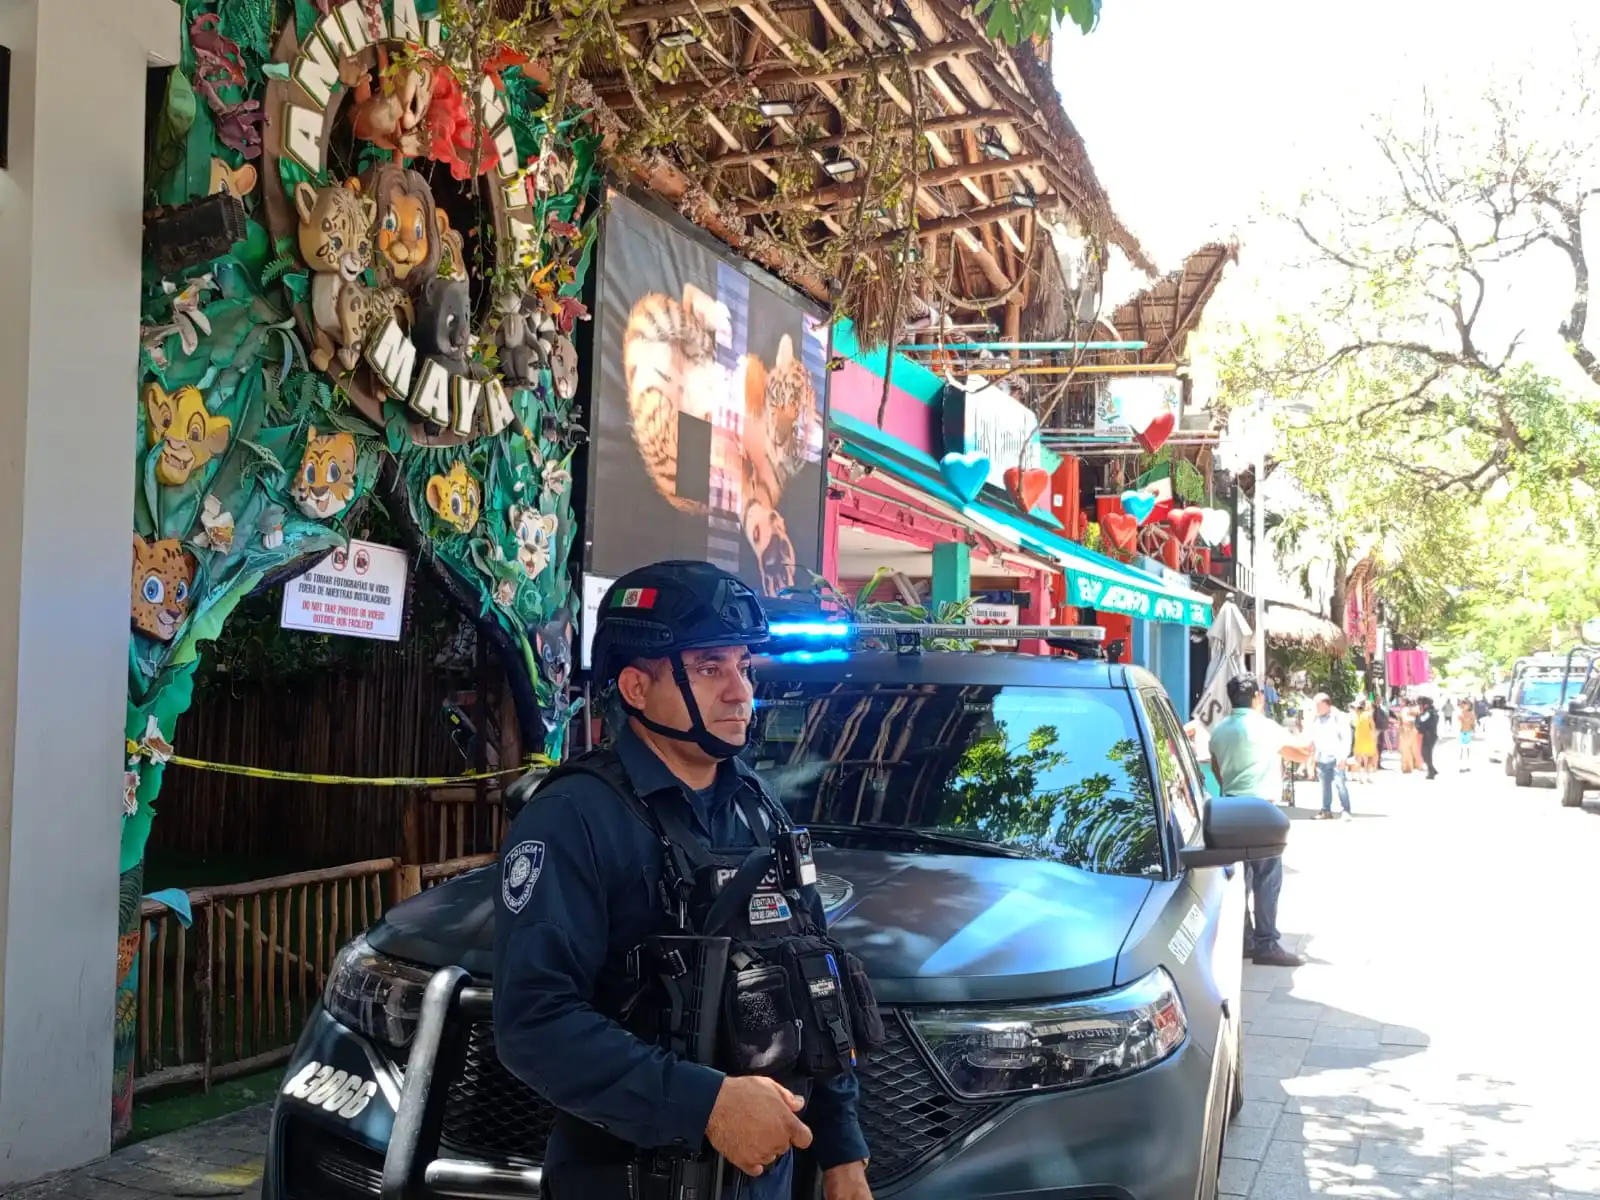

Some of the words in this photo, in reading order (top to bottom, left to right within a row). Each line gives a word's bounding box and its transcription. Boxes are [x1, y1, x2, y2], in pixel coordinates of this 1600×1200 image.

[366, 316, 516, 437] MAYA
[313, 573, 333, 585] TOMAR
[299, 583, 316, 595] FUERA
[317, 586, 324, 596] DE
[325, 587, 353, 600] NUESTRAS
[354, 591, 391, 606] INSTALACIONES
[302, 600, 311, 611] DO
[311, 601, 323, 612] NOT
[324, 602, 337, 615] TAKE
[313, 613, 335, 625] OUTSIDE
[336, 616, 347, 627] OUR
